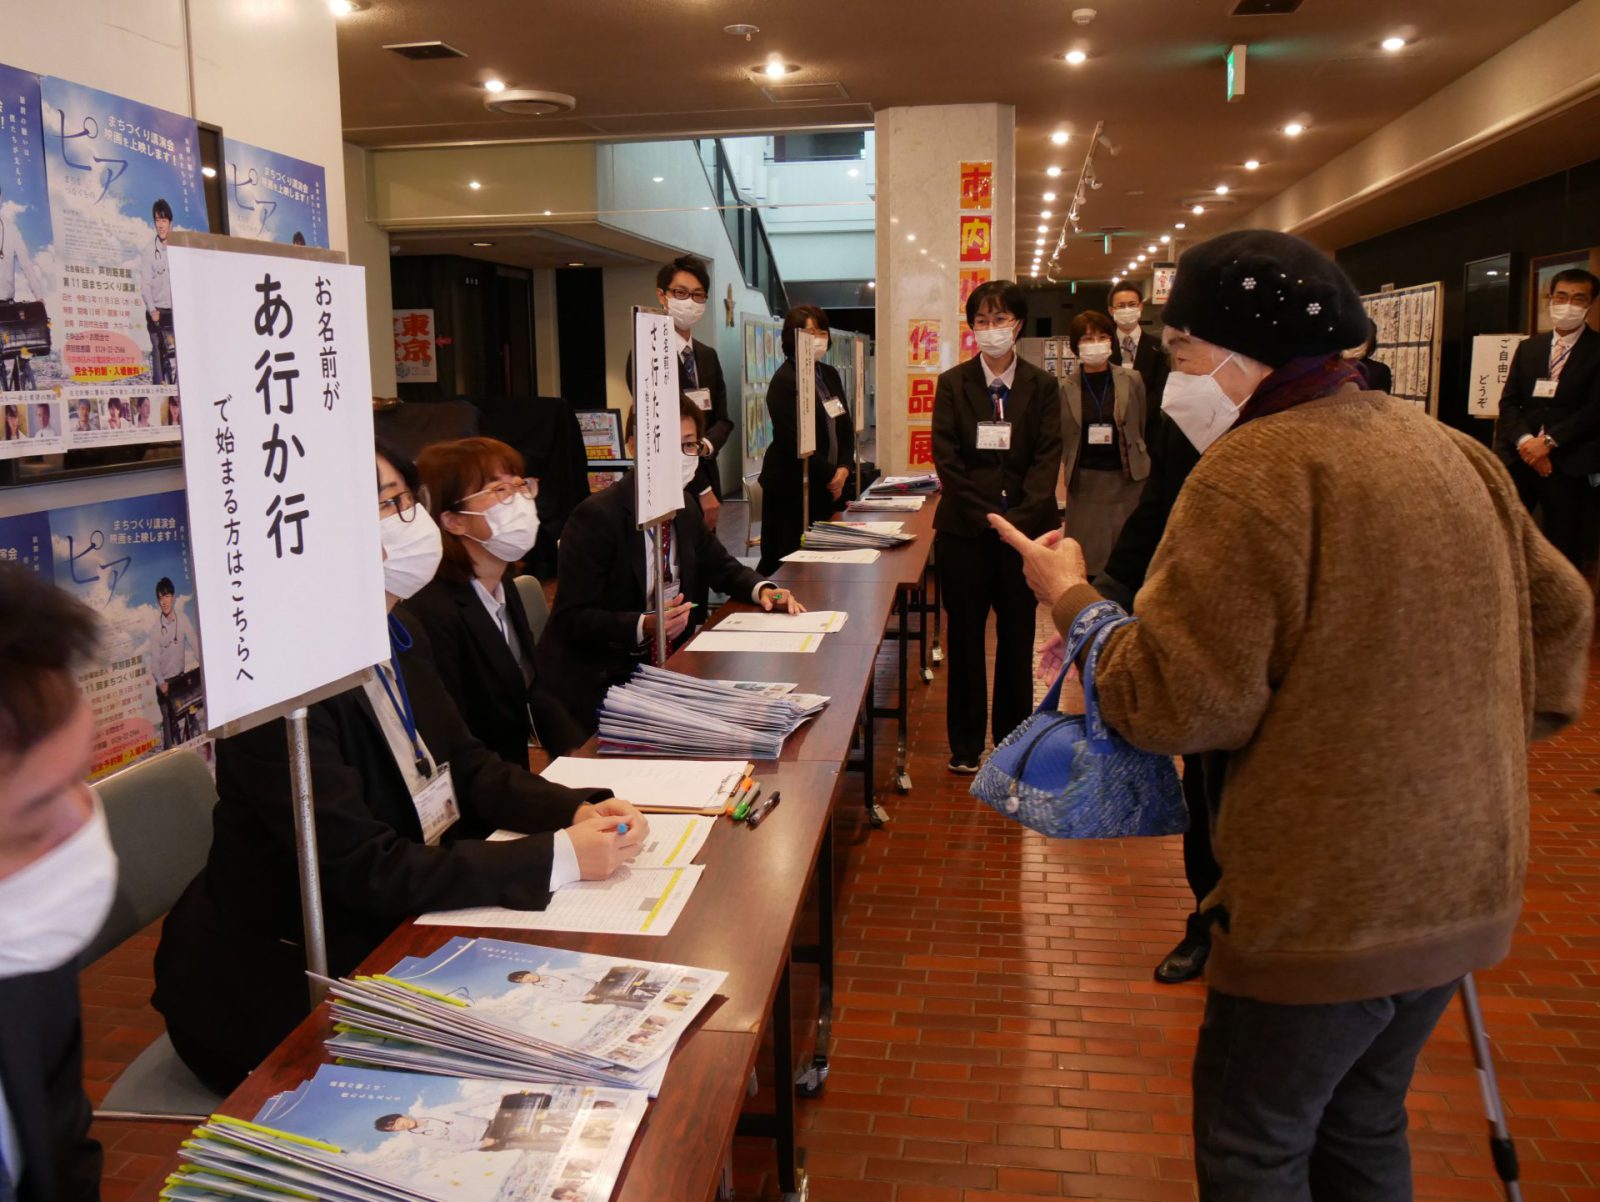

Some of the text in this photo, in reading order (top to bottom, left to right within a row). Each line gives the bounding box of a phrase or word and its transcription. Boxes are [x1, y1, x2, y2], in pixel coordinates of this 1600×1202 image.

[54, 108, 128, 205] ピア
[108, 115, 175, 152] まちづくり講演会
[231, 163, 277, 237] ピア
[314, 275, 341, 412] お名前が
[253, 272, 310, 560] あ行か行
[1477, 373, 1490, 409] どうぞ
[113, 517, 177, 531] まちづくり講演会
[213, 394, 254, 682] で始まる方はこちらへ
[62, 529, 132, 609] ピア
